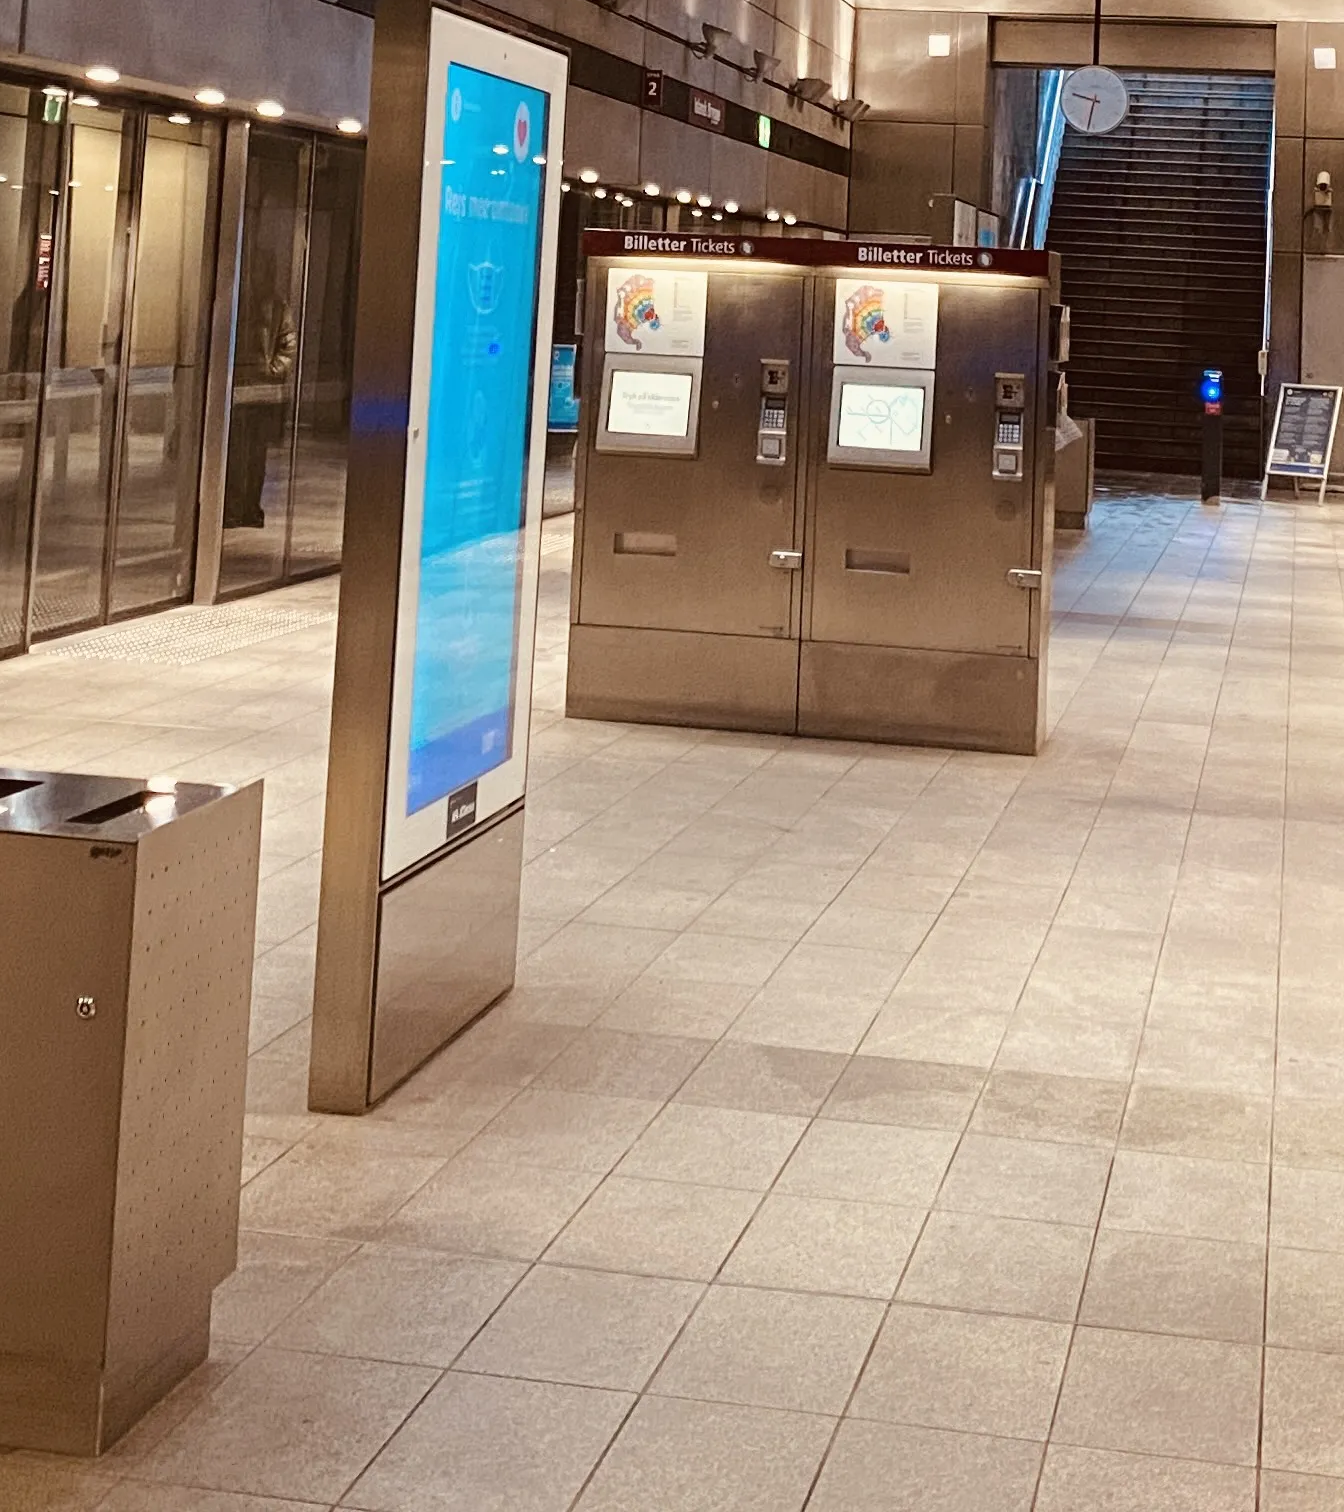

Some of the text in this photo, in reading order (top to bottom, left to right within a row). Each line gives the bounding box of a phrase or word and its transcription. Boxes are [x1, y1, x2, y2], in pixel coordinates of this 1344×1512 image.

[648, 82, 657, 96] 2
[624, 235, 735, 254] Billetter Tickets
[857, 247, 973, 266] Billetter Tickets
